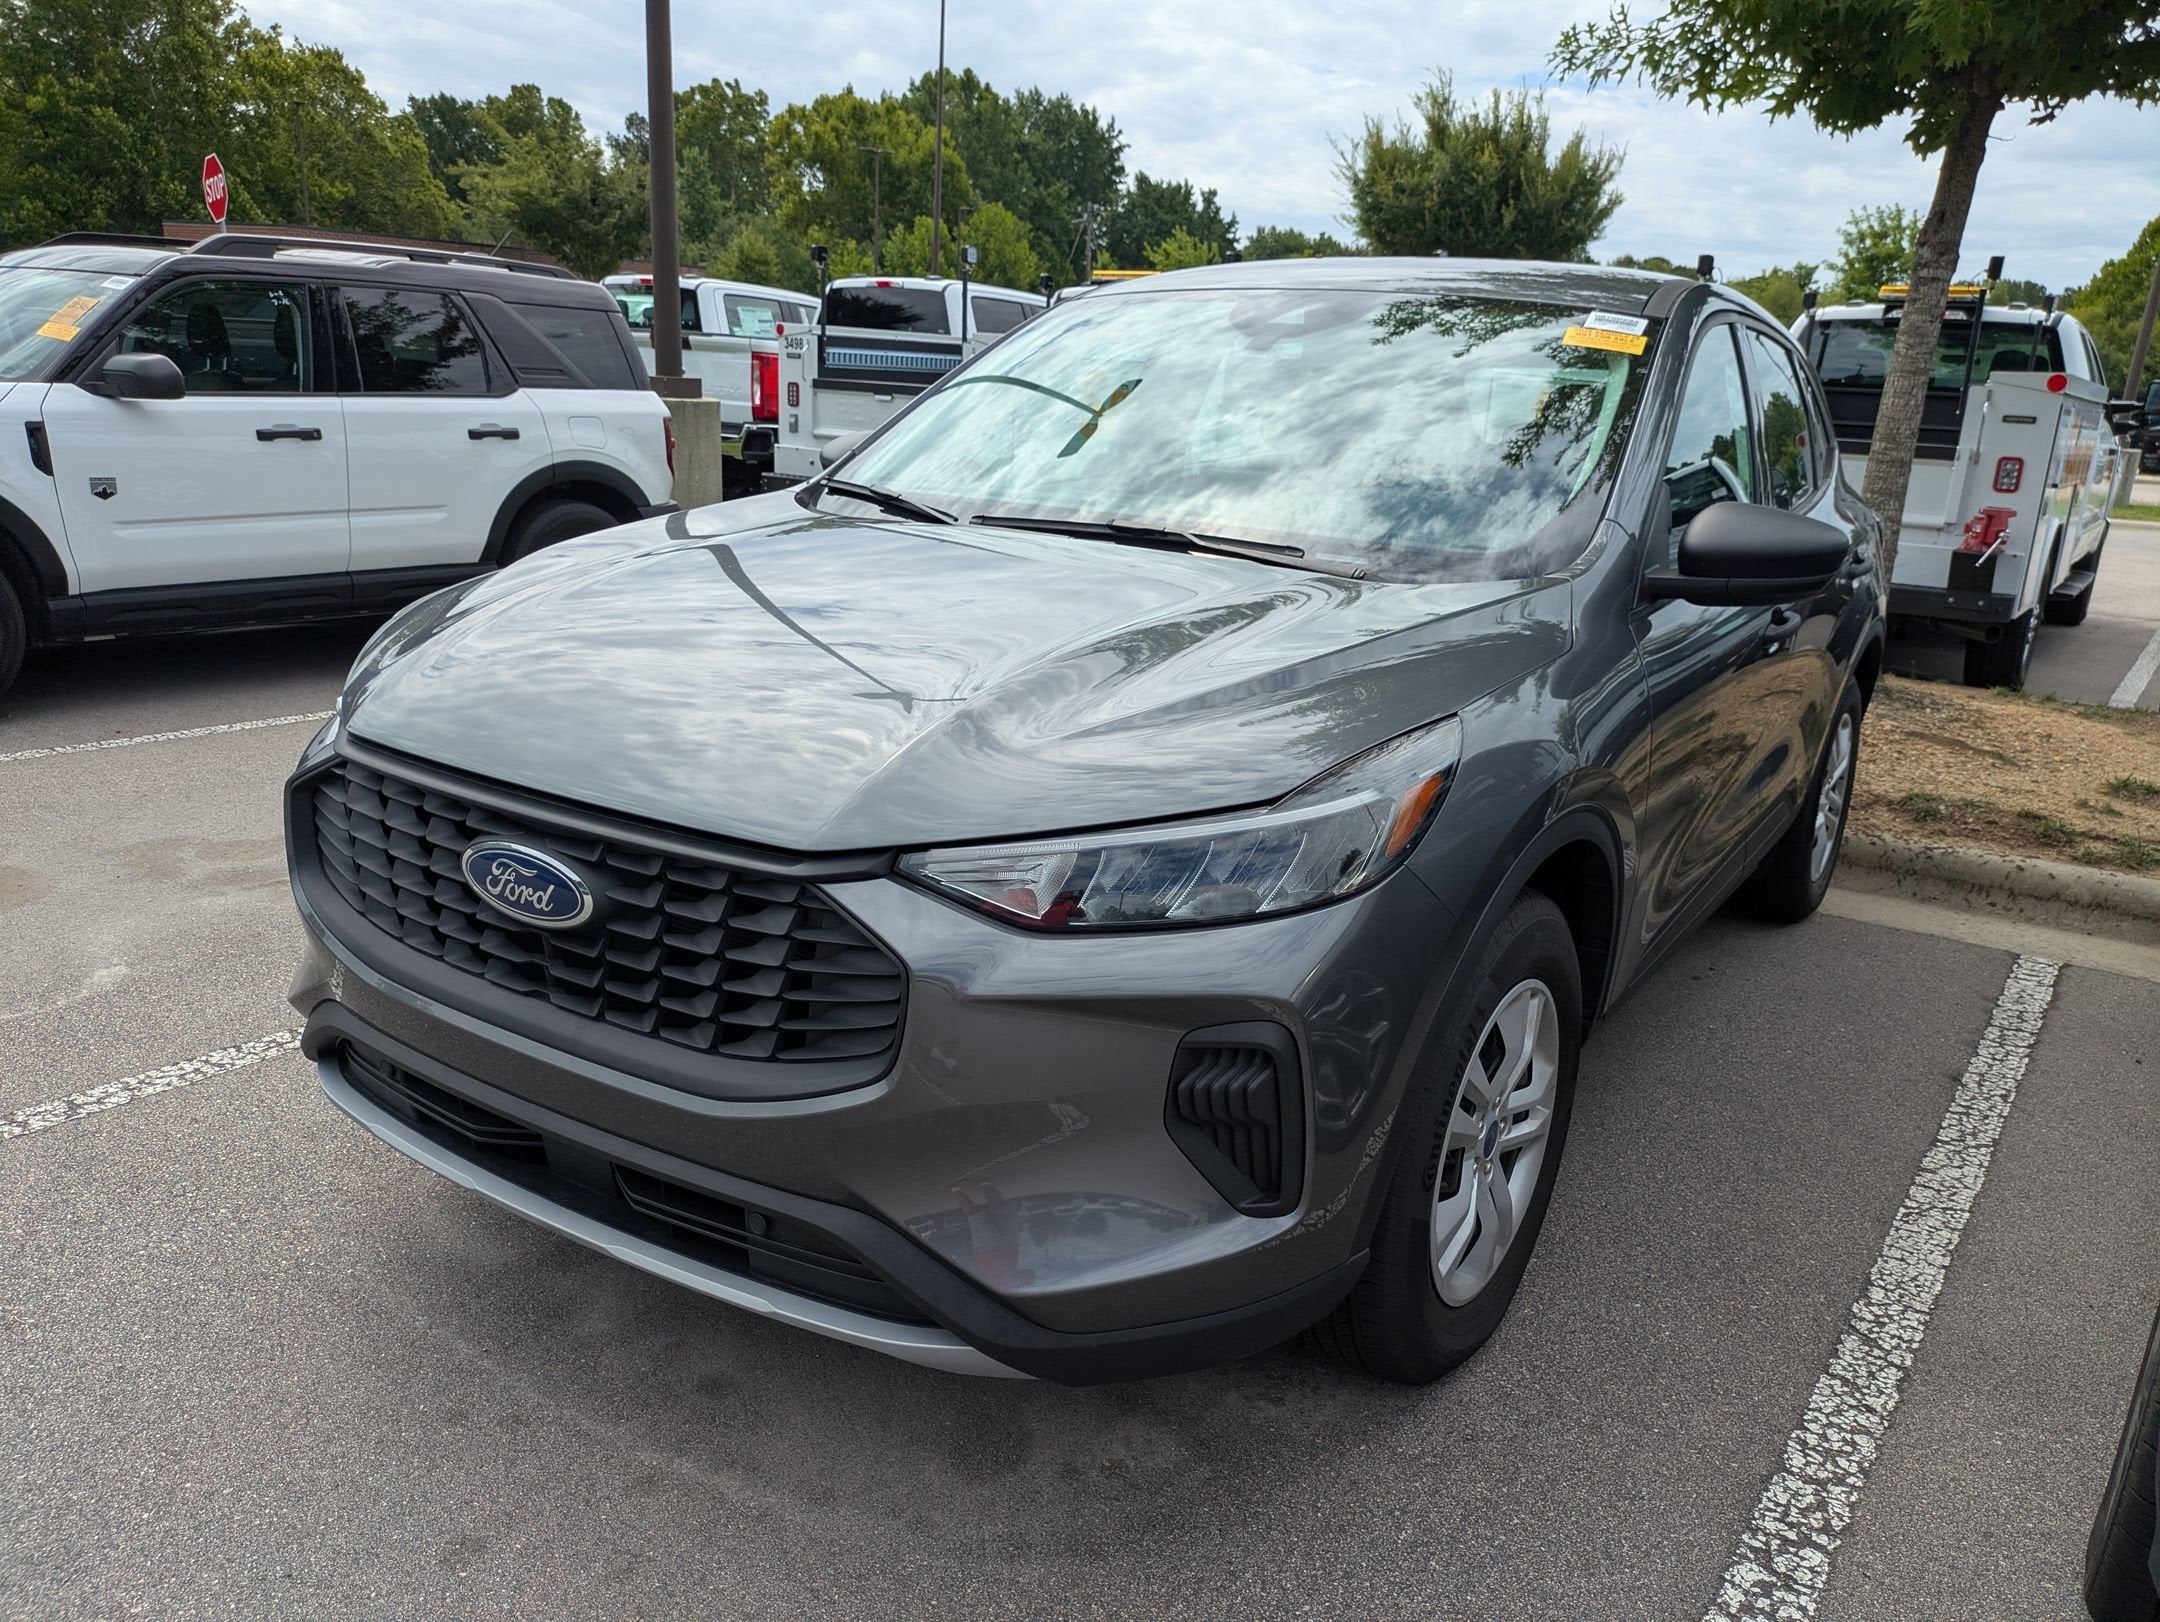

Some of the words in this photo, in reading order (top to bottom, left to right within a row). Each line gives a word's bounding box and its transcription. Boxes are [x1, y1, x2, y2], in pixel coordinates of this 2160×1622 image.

[206, 174, 224, 203] STOP
[784, 337, 804, 350] 3498
[485, 857, 555, 912] Ford
